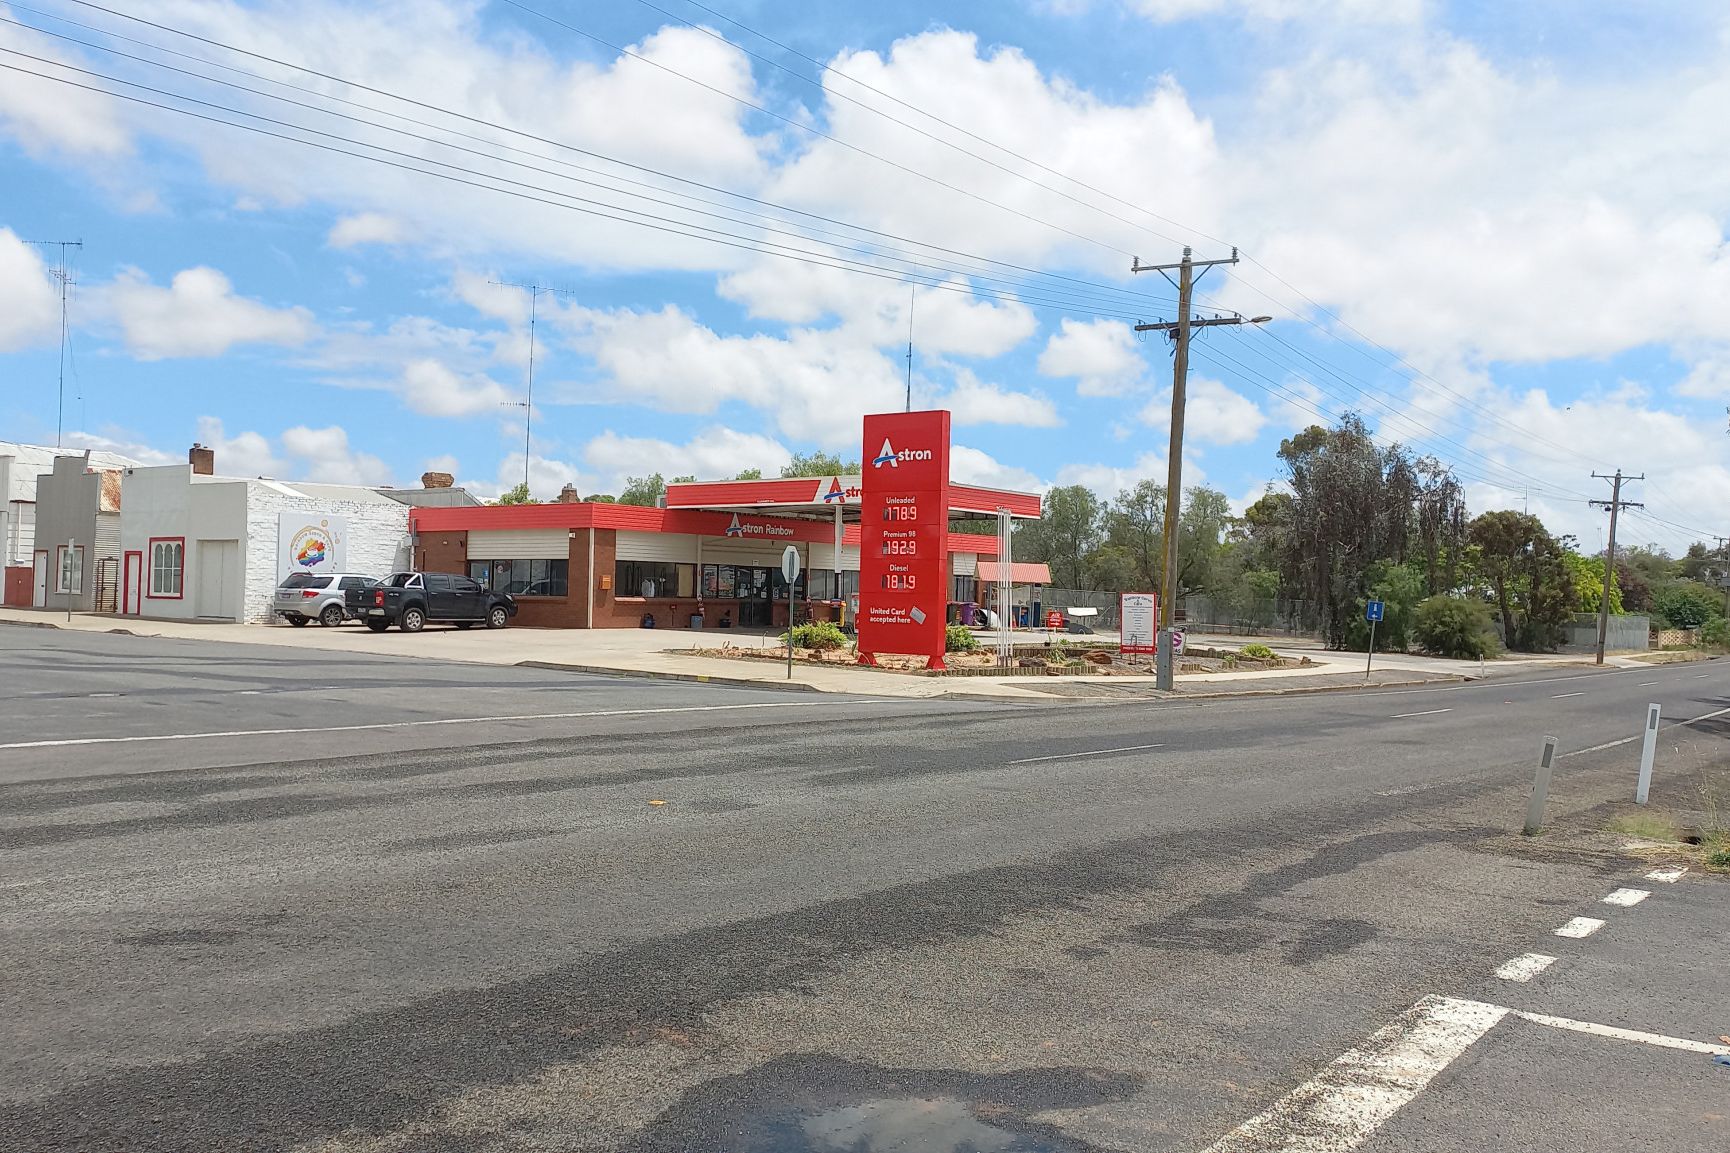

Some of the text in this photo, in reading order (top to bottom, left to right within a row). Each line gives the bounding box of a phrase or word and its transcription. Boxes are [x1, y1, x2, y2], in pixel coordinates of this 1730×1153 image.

[872, 437, 931, 468] Astron
[824, 476, 863, 504] Astr
[885, 496, 916, 505] Unleaded
[726, 512, 794, 537] Astron Rainbow
[883, 530, 908, 538] Premium
[889, 563, 909, 572] Diesel
[869, 607, 906, 616] United Card
[869, 616, 897, 625] accepted
[897, 616, 911, 624] here
